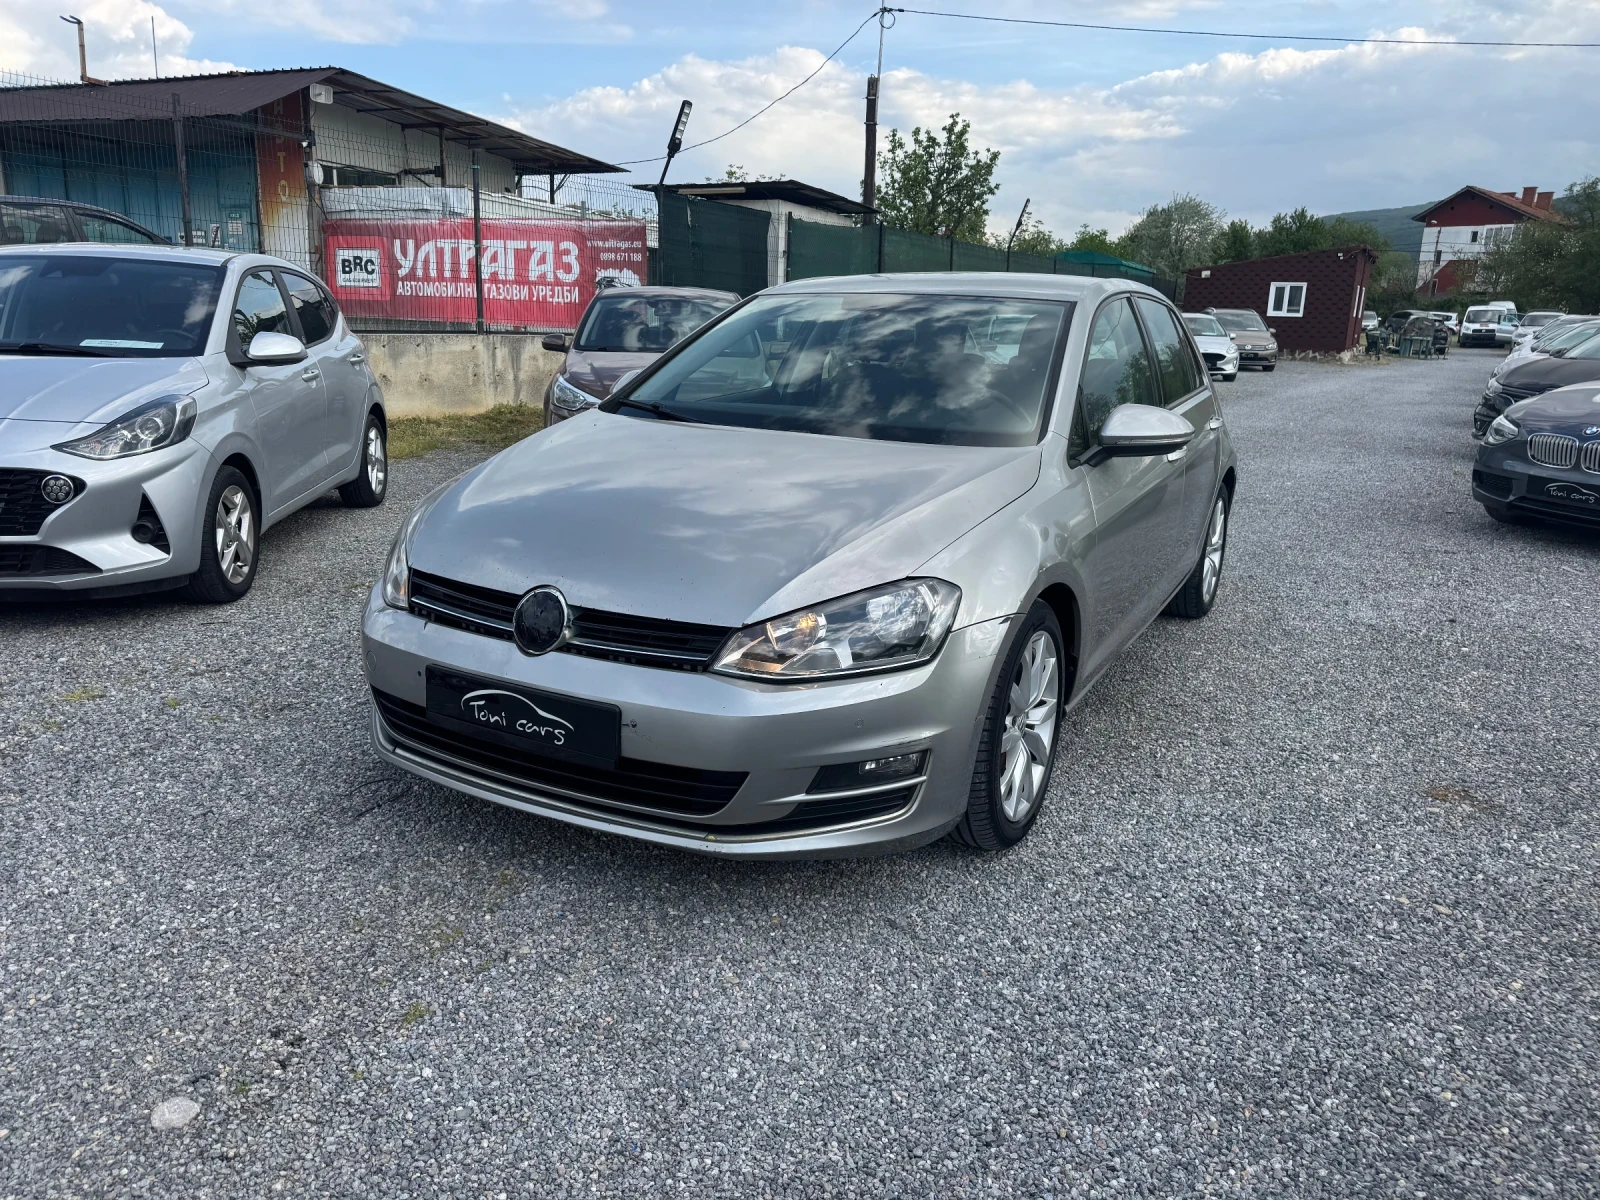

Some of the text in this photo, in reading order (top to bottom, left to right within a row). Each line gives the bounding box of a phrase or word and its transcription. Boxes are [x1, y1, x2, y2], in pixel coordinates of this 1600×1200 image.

[341, 255, 376, 275] BRC
[394, 239, 580, 283] УЛТРАГАЗ
[600, 252, 642, 262] 0898 671 188
[484, 283, 529, 301] ГАЗОВИ
[531, 285, 579, 305] УРЕДБИ
[1549, 487, 1595, 504] Toni cars
[469, 700, 566, 745] Toni cars
